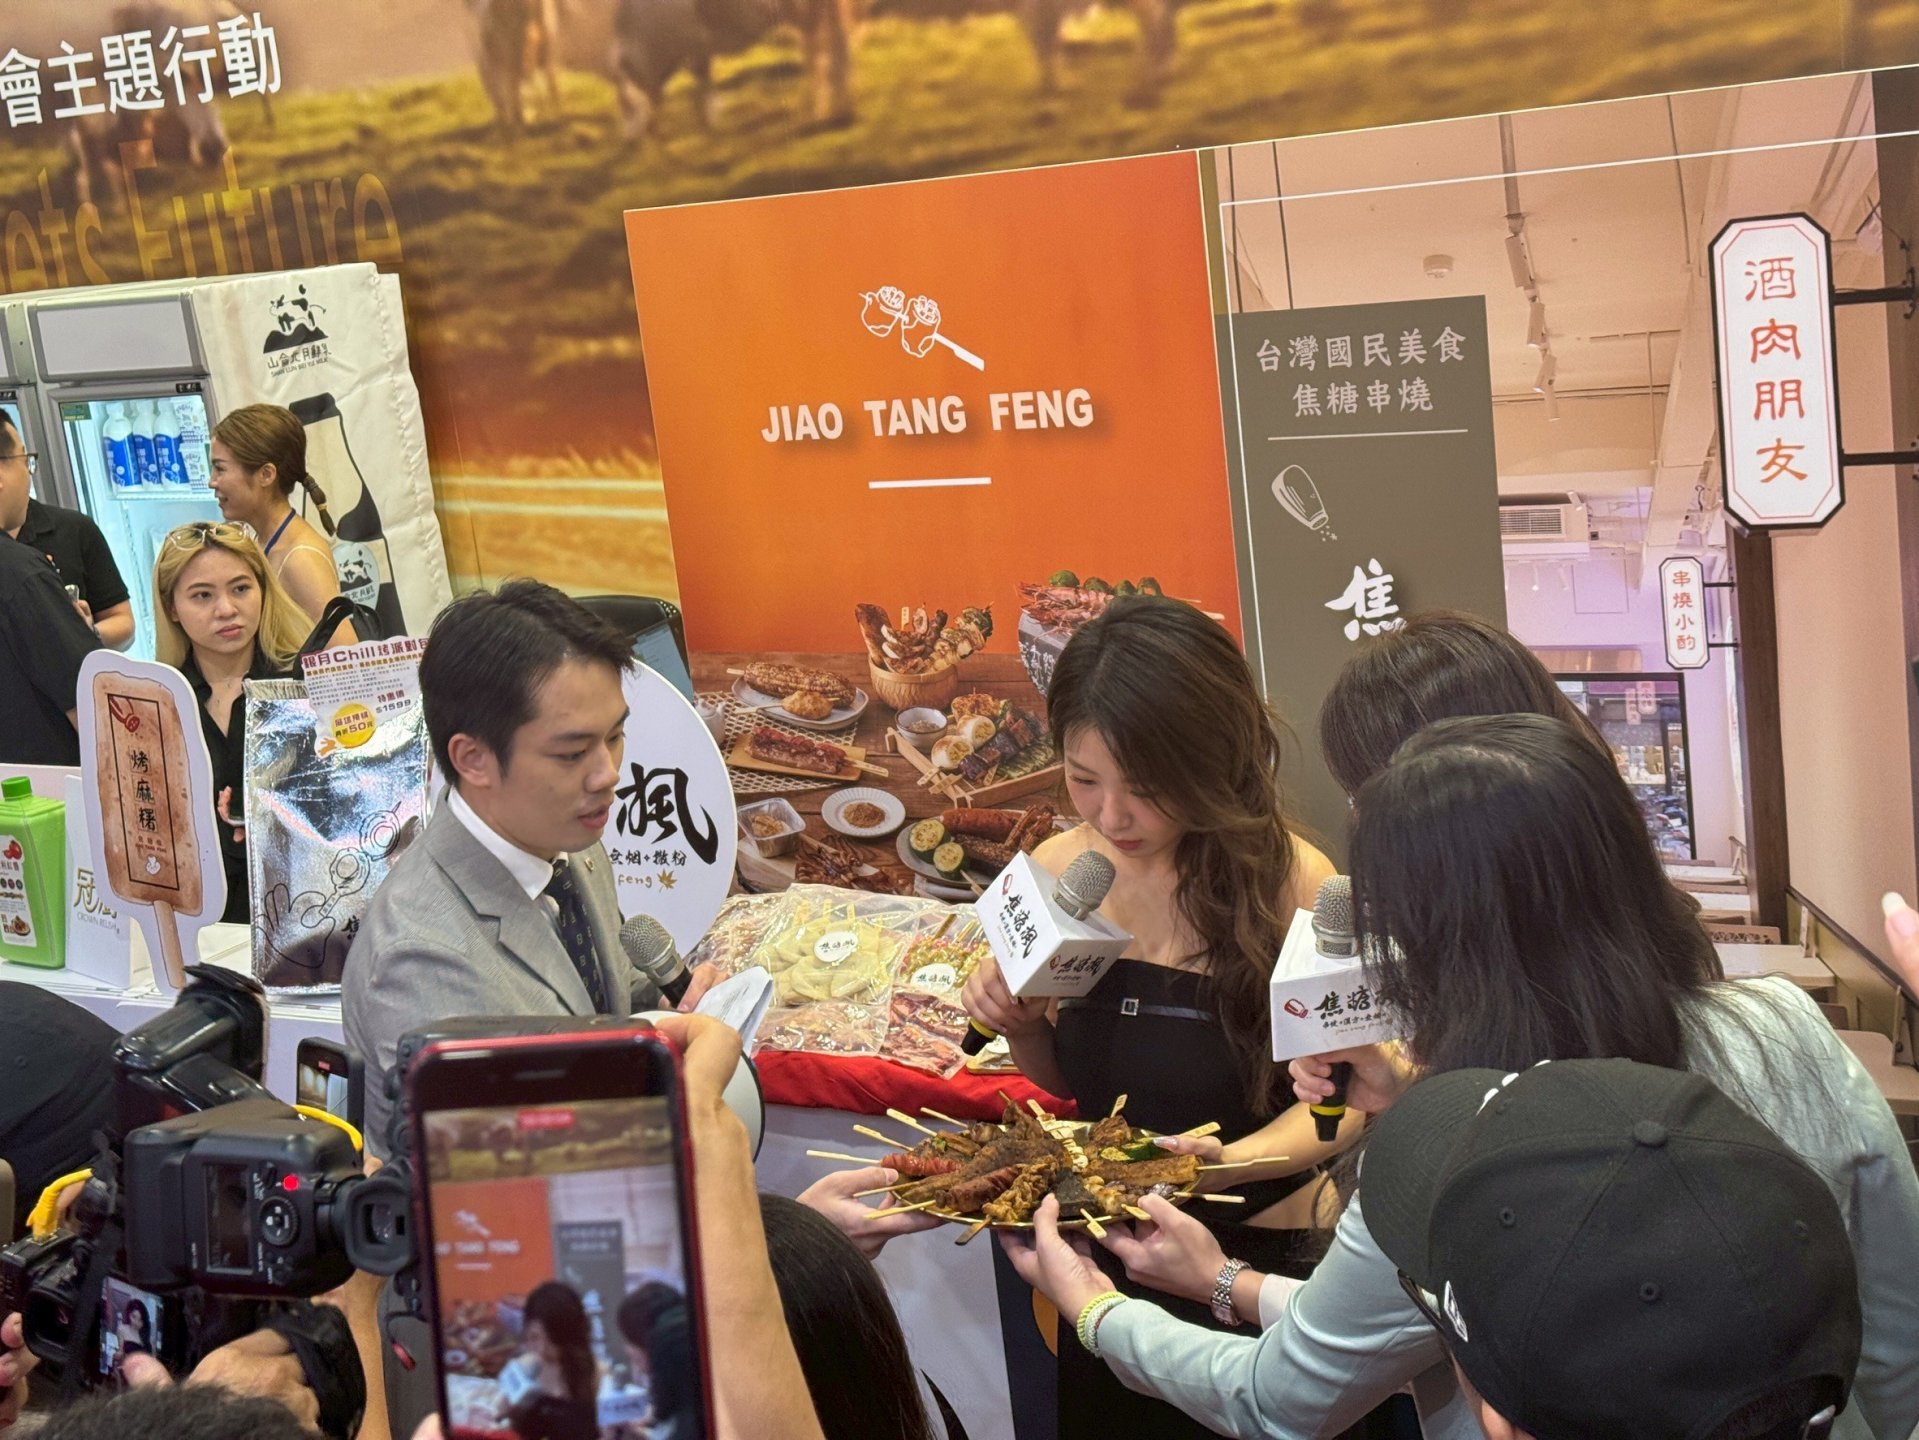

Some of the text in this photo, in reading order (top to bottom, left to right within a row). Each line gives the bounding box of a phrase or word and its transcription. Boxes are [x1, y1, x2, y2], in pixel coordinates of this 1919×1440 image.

[0, 12, 283, 128] 會主題行動
[1256, 326, 1466, 372] 台灣國民美食
[1744, 256, 1809, 484] 酒肉朋友
[760, 388, 1094, 443] JIAO TANG FENG
[1293, 376, 1434, 417] 焦糖串燒
[1324, 557, 1407, 641] 焦
[1672, 570, 1696, 650] 串燒小酌
